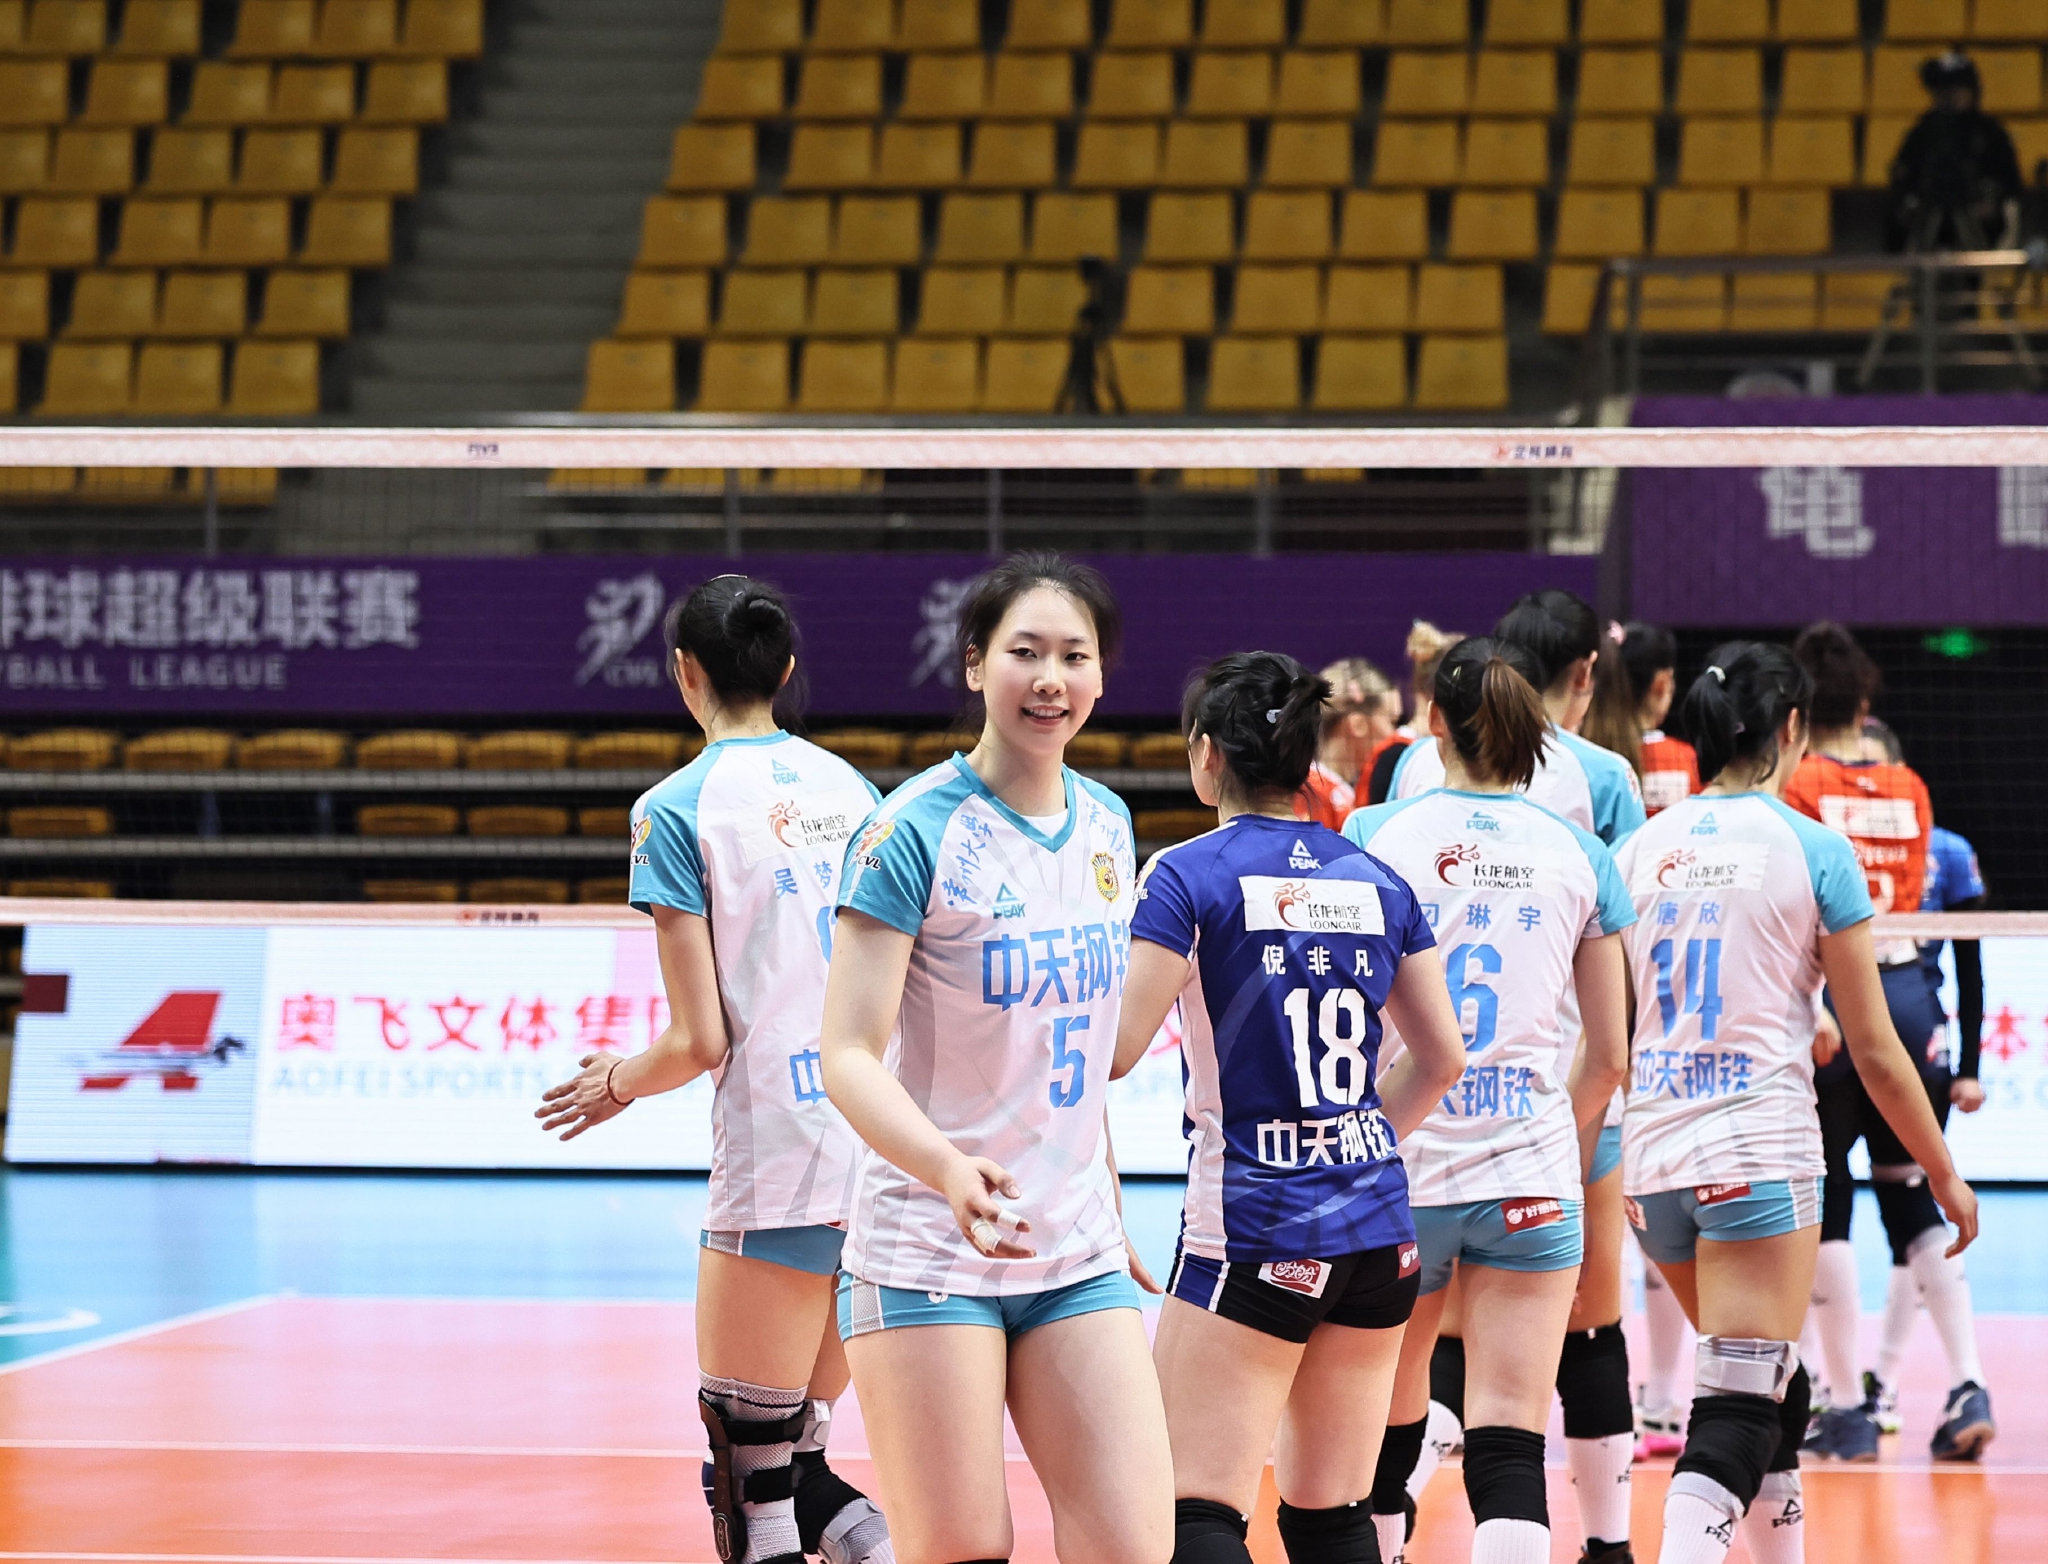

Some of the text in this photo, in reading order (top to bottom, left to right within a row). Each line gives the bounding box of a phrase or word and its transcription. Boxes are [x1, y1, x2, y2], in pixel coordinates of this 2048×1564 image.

[0, 654, 288, 690] BALL LEAGUE
[772, 772, 802, 785] PEAK
[1466, 820, 1500, 831] PEAK
[1690, 826, 1720, 835] PEAK
[857, 855, 881, 869] CVL
[1288, 856, 1322, 870] PEAK
[1473, 879, 1534, 890] LOONGAIR
[992, 903, 1026, 919] PEAK
[1657, 901, 1721, 925] 唐欣
[1309, 919, 1362, 931] LOONGAIR
[1262, 945, 1373, 977] 倪非凡
[1445, 943, 1502, 1052] 6
[1651, 939, 1723, 1041] 14
[1284, 988, 1369, 1108] 18
[1049, 1015, 1090, 1108] 5
[1636, 1049, 1753, 1099] 中天钢铁
[1256, 1108, 1391, 1167] 中天钢铁
